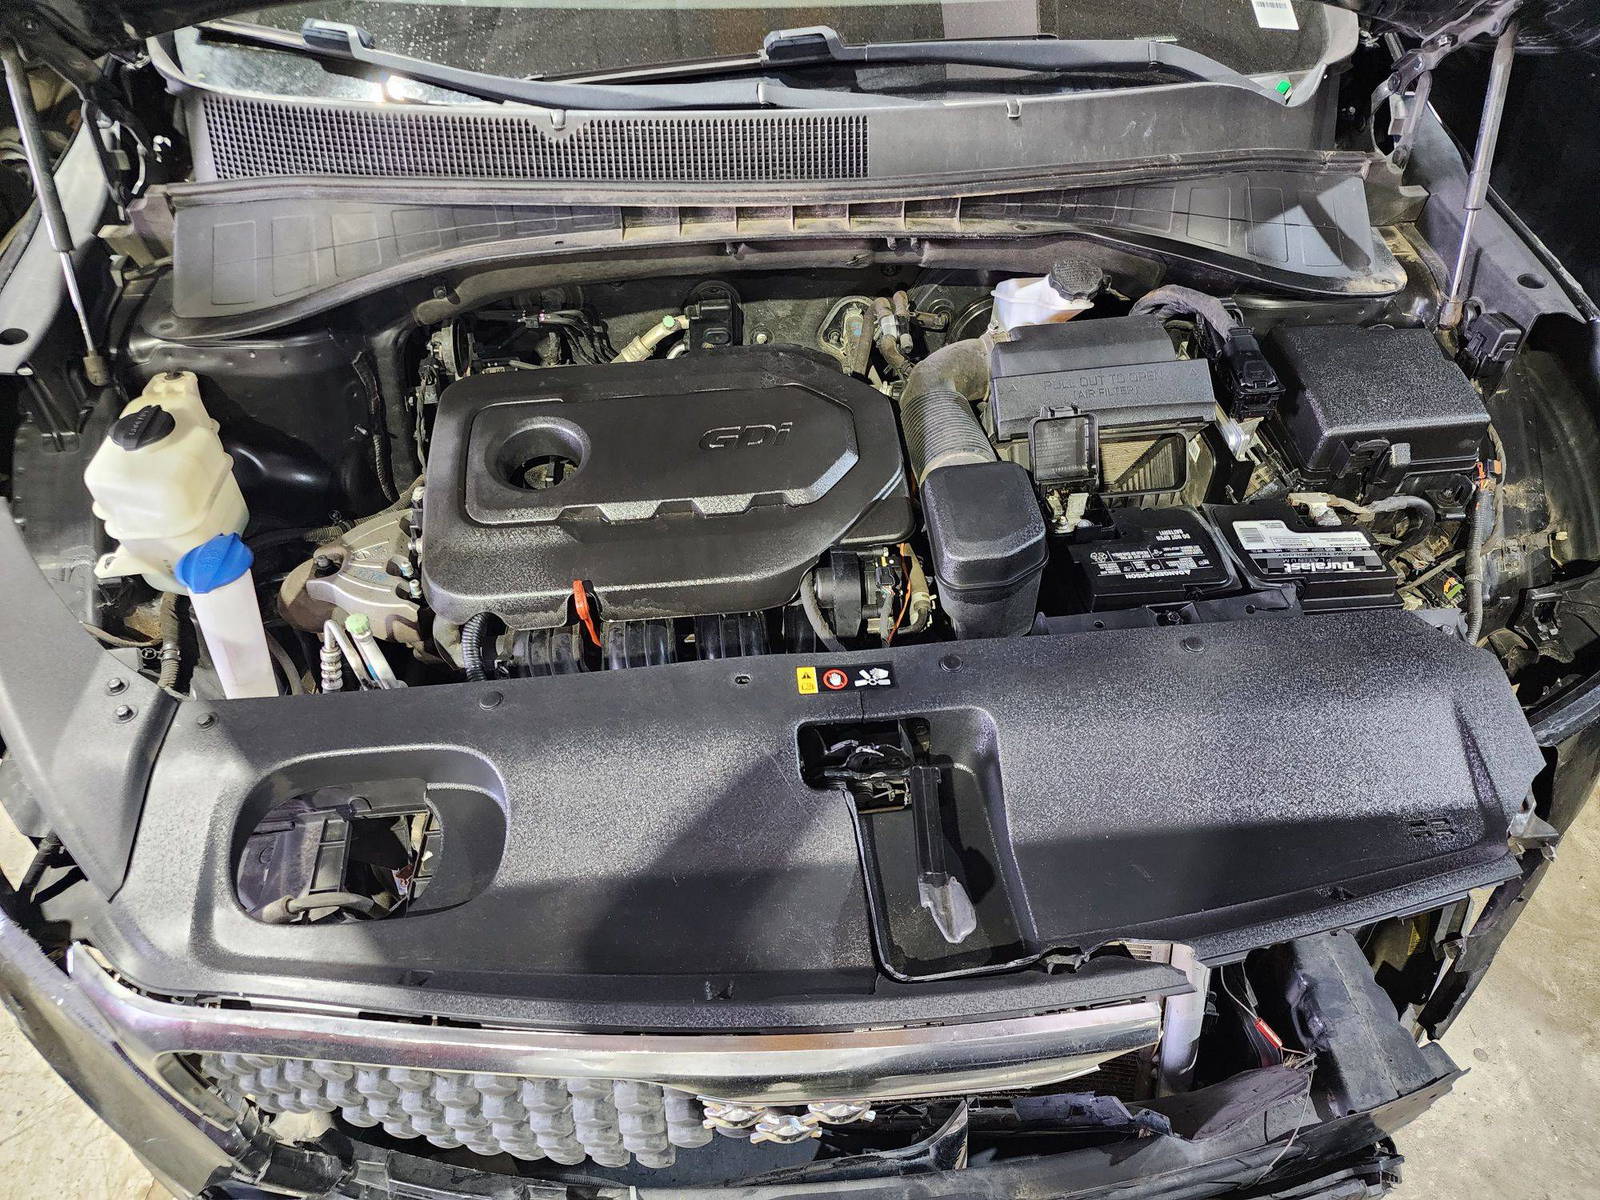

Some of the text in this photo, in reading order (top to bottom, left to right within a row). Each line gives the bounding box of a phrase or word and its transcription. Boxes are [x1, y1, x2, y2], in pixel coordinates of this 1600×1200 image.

[1079, 374, 1105, 387] OUT
[1109, 372, 1126, 385] TO
[1128, 369, 1164, 383] OPEN
[699, 421, 793, 451] GDi
[1283, 561, 1355, 573] Duralast
